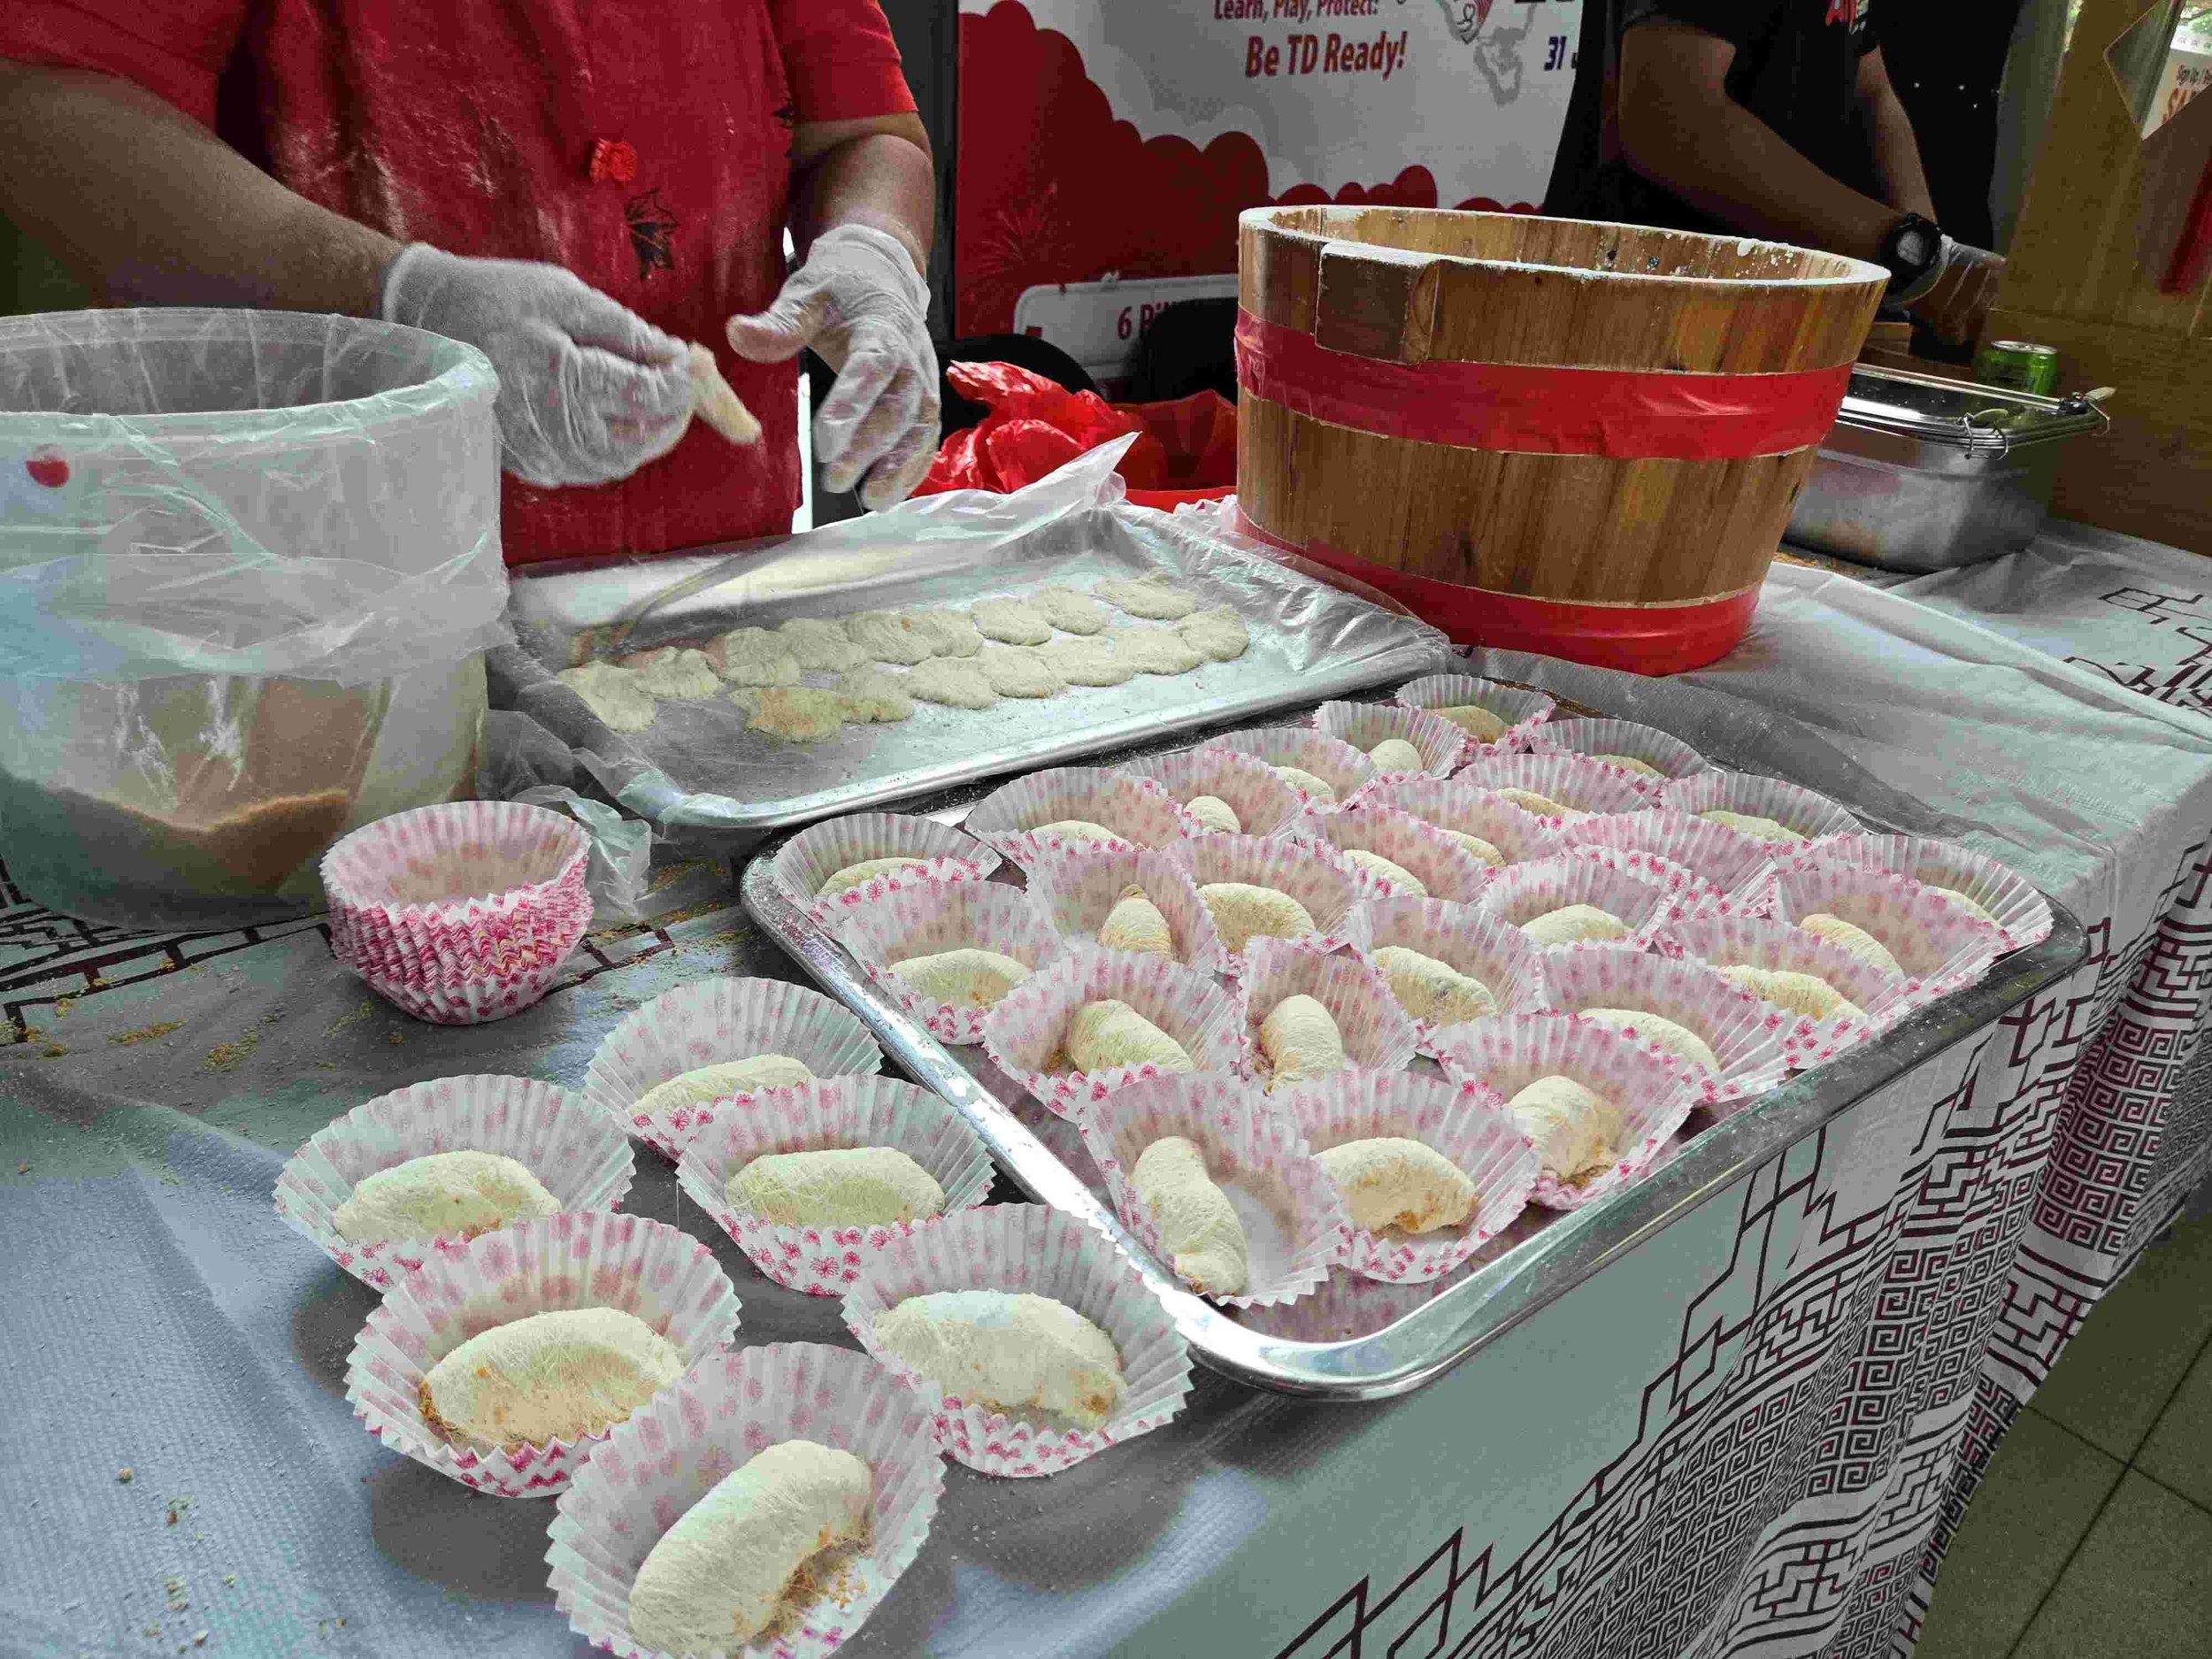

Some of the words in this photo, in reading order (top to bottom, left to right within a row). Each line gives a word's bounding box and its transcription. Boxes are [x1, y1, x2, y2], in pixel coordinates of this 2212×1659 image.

[1214, 0, 1268, 23] Learn,
[1272, 0, 1311, 23] Play,
[1245, 35, 1279, 78] Be
[1287, 34, 1318, 75] TD
[1323, 30, 1408, 81] Ready!
[1543, 35, 1567, 71] 31
[1118, 306, 1133, 340] 6
